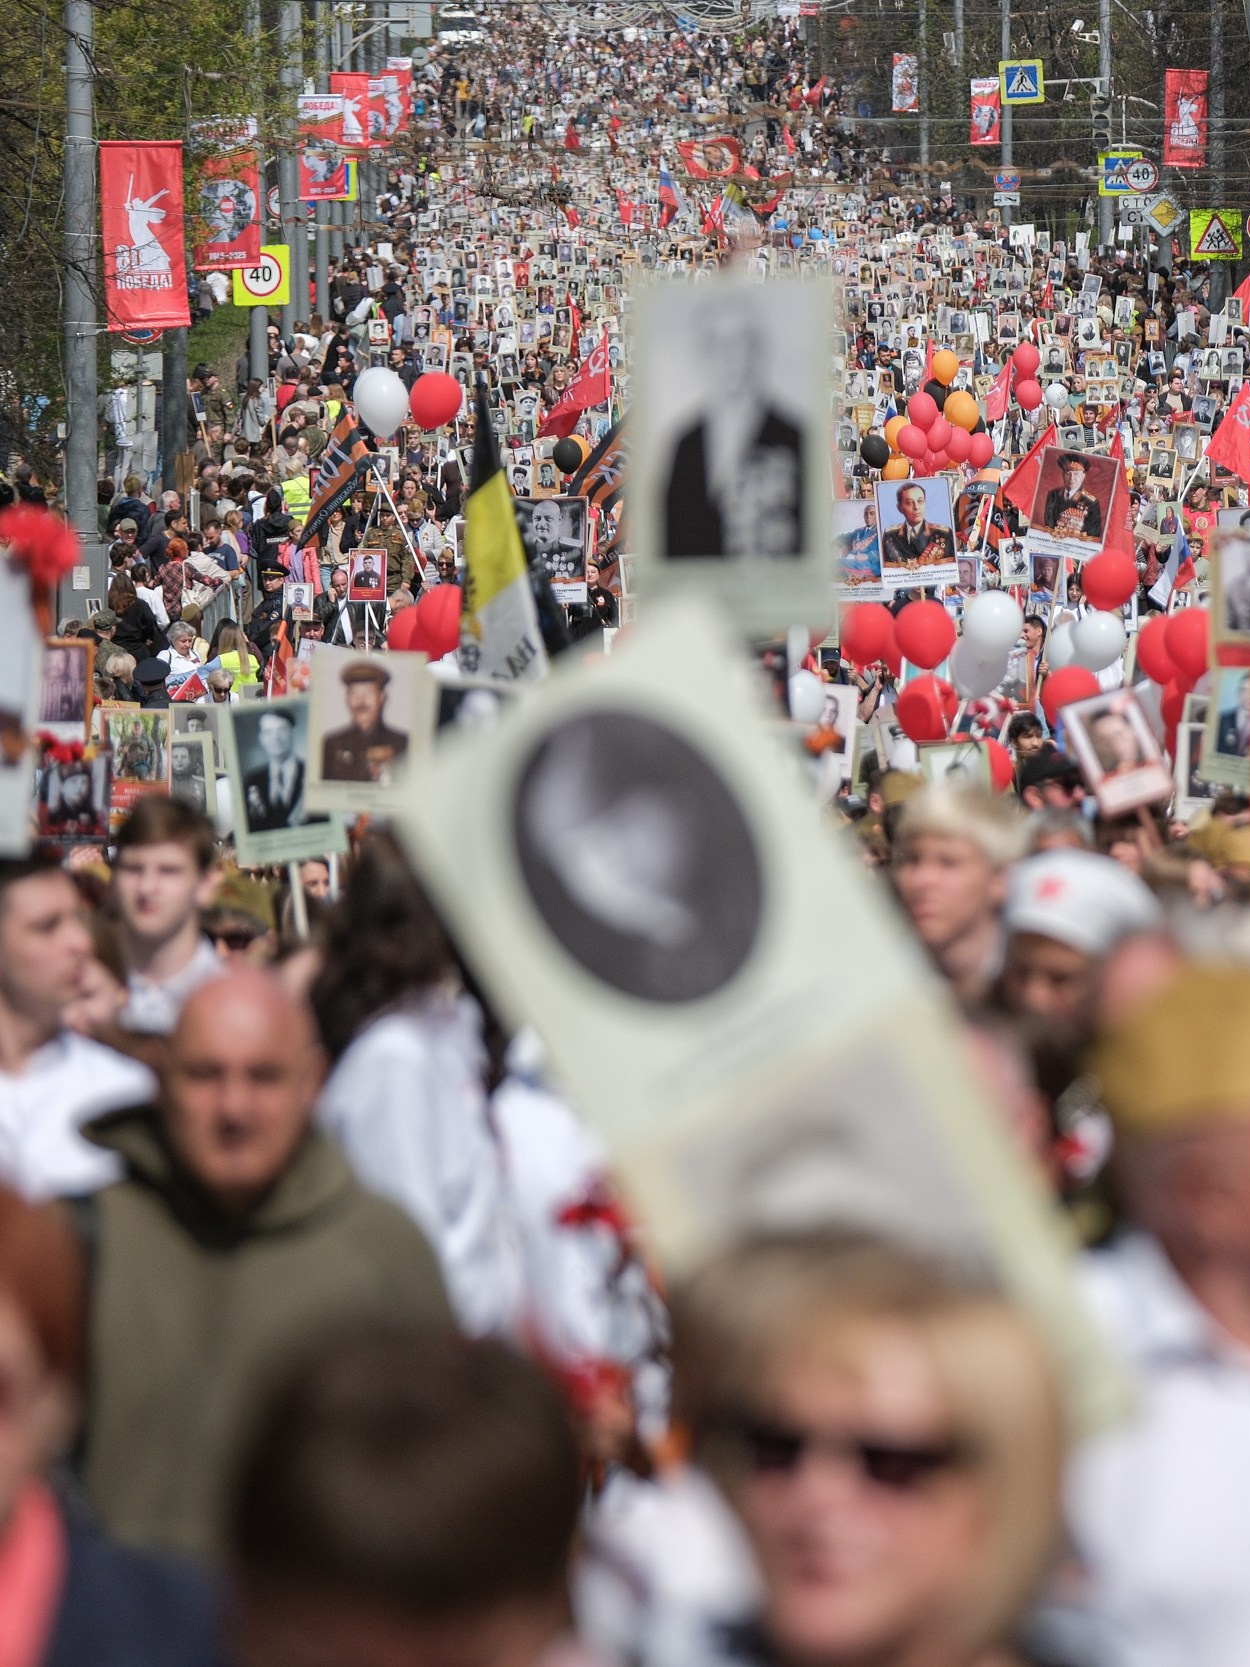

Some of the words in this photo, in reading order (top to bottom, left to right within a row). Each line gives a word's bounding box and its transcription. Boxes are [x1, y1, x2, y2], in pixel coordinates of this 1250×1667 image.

[1133, 168, 1149, 180] 40
[116, 274, 172, 290] ПОБЕДА!
[250, 266, 272, 282] 40
